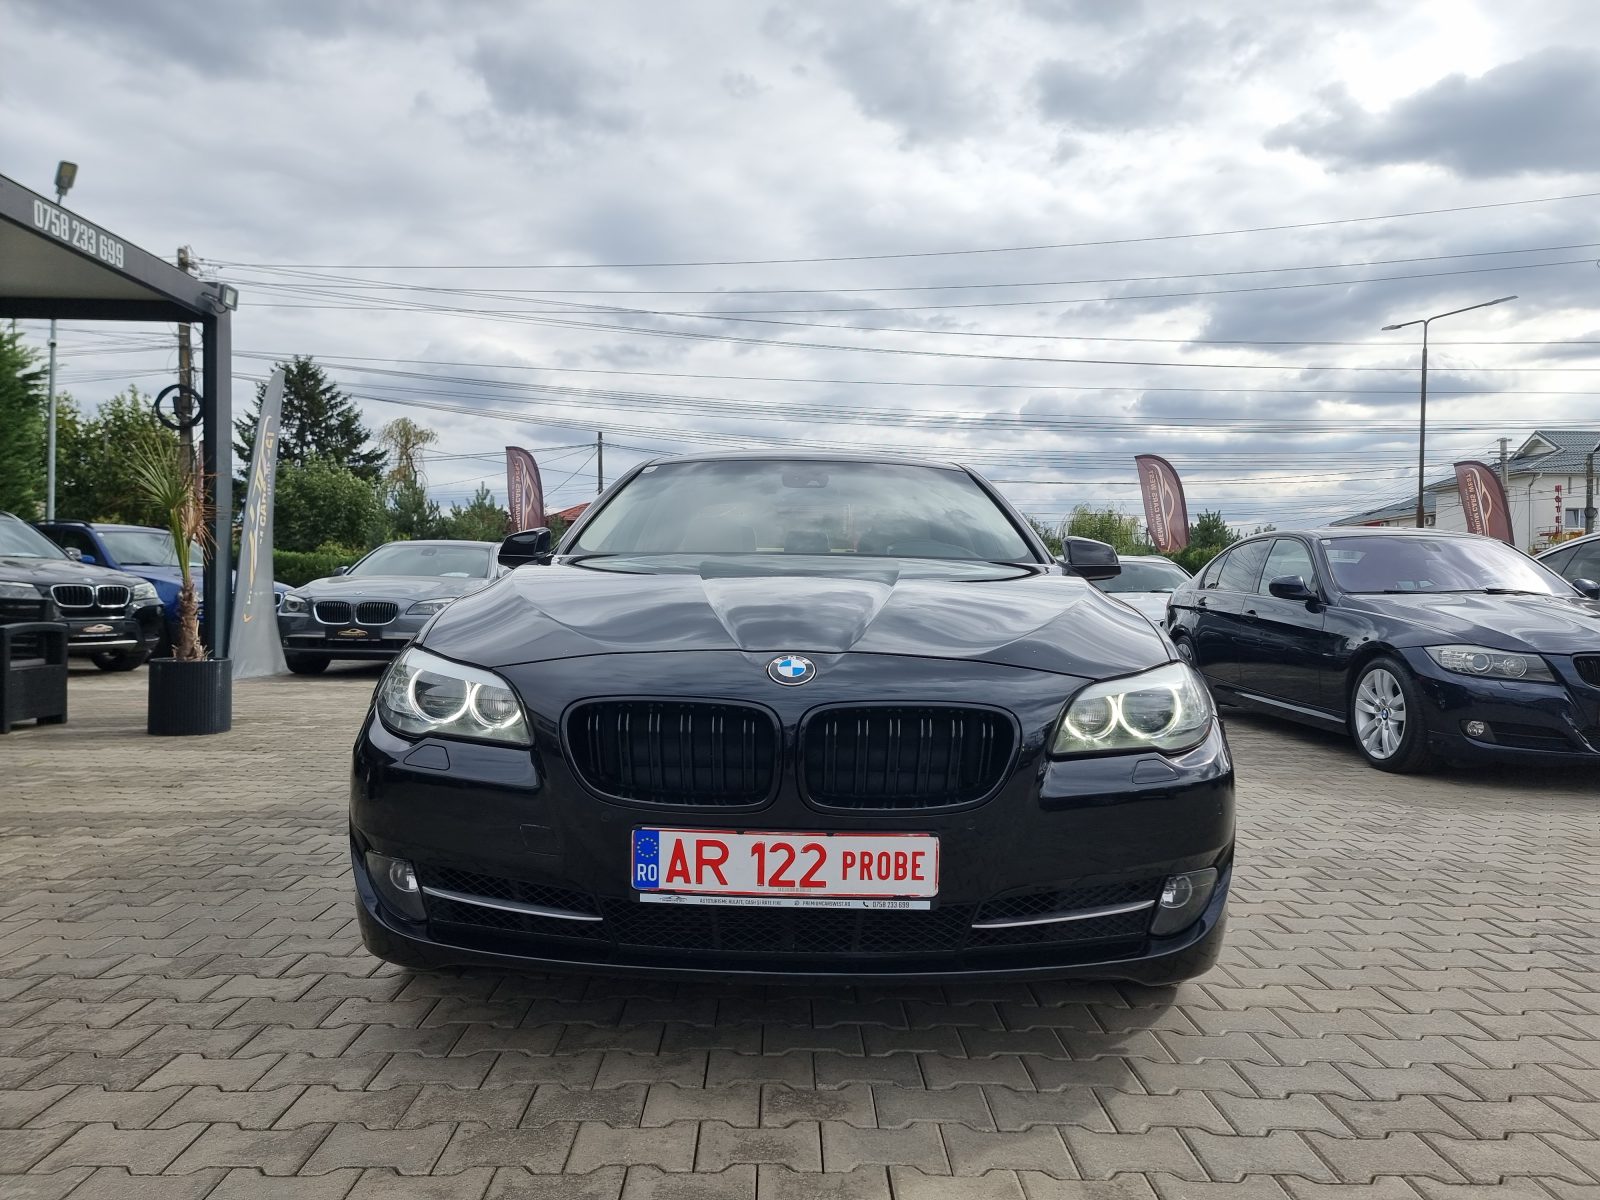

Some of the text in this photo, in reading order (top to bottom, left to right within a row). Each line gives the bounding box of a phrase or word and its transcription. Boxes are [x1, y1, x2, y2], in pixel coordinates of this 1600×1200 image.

[34, 200, 124, 269] 0758 233 699
[637, 863, 657, 882] RO
[665, 838, 926, 888] AR 122 PROBE
[898, 901, 910, 909] 699
